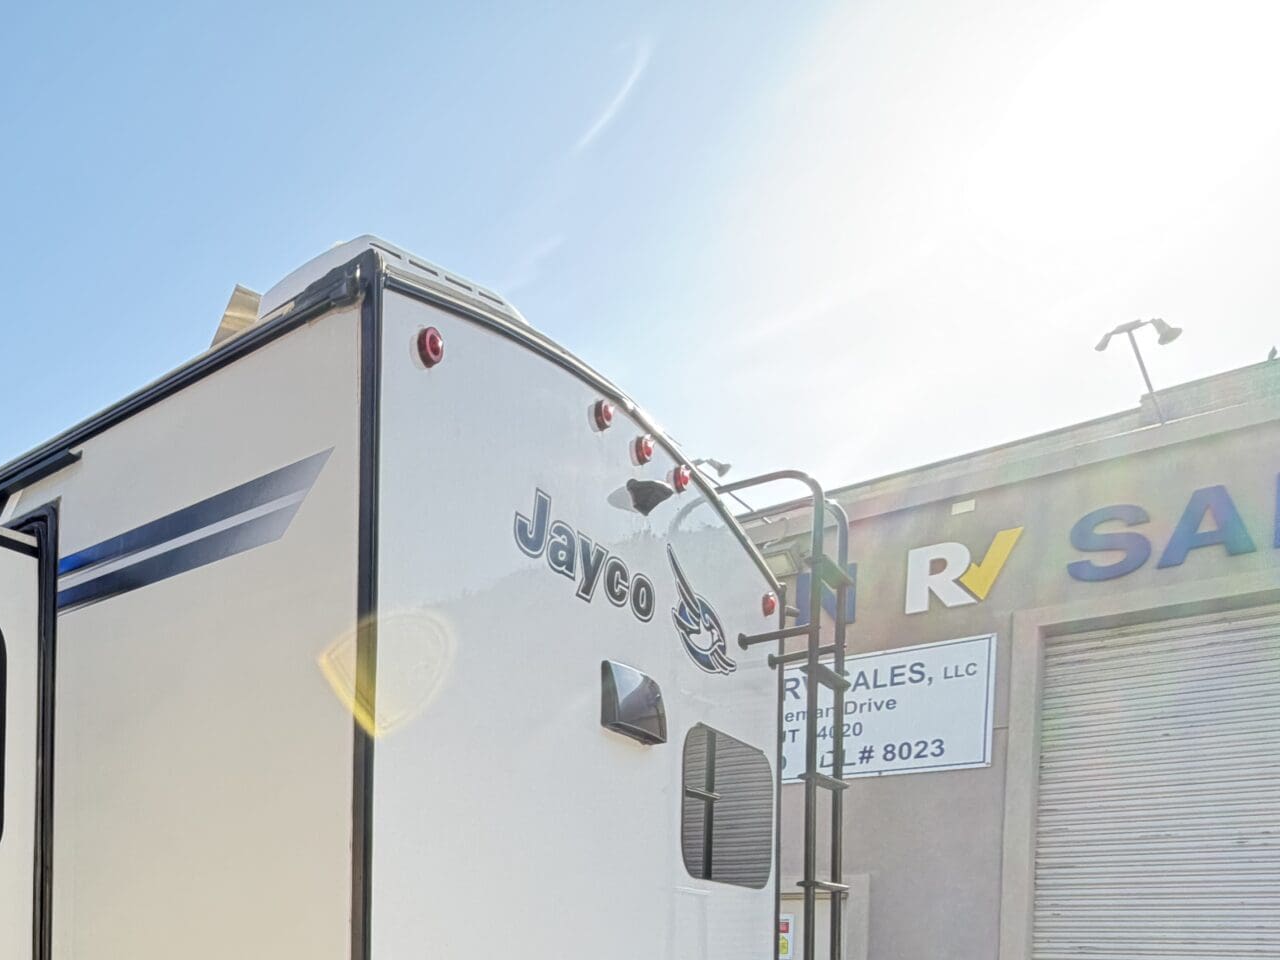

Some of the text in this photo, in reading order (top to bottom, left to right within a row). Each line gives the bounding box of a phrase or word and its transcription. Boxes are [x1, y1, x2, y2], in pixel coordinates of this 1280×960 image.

[1067, 472, 1280, 583] SA
[513, 487, 656, 623] Jayco
[841, 662, 934, 693] ALES,
[943, 662, 978, 680] LLC
[844, 698, 897, 716] Drive
[882, 738, 945, 762] 8023
